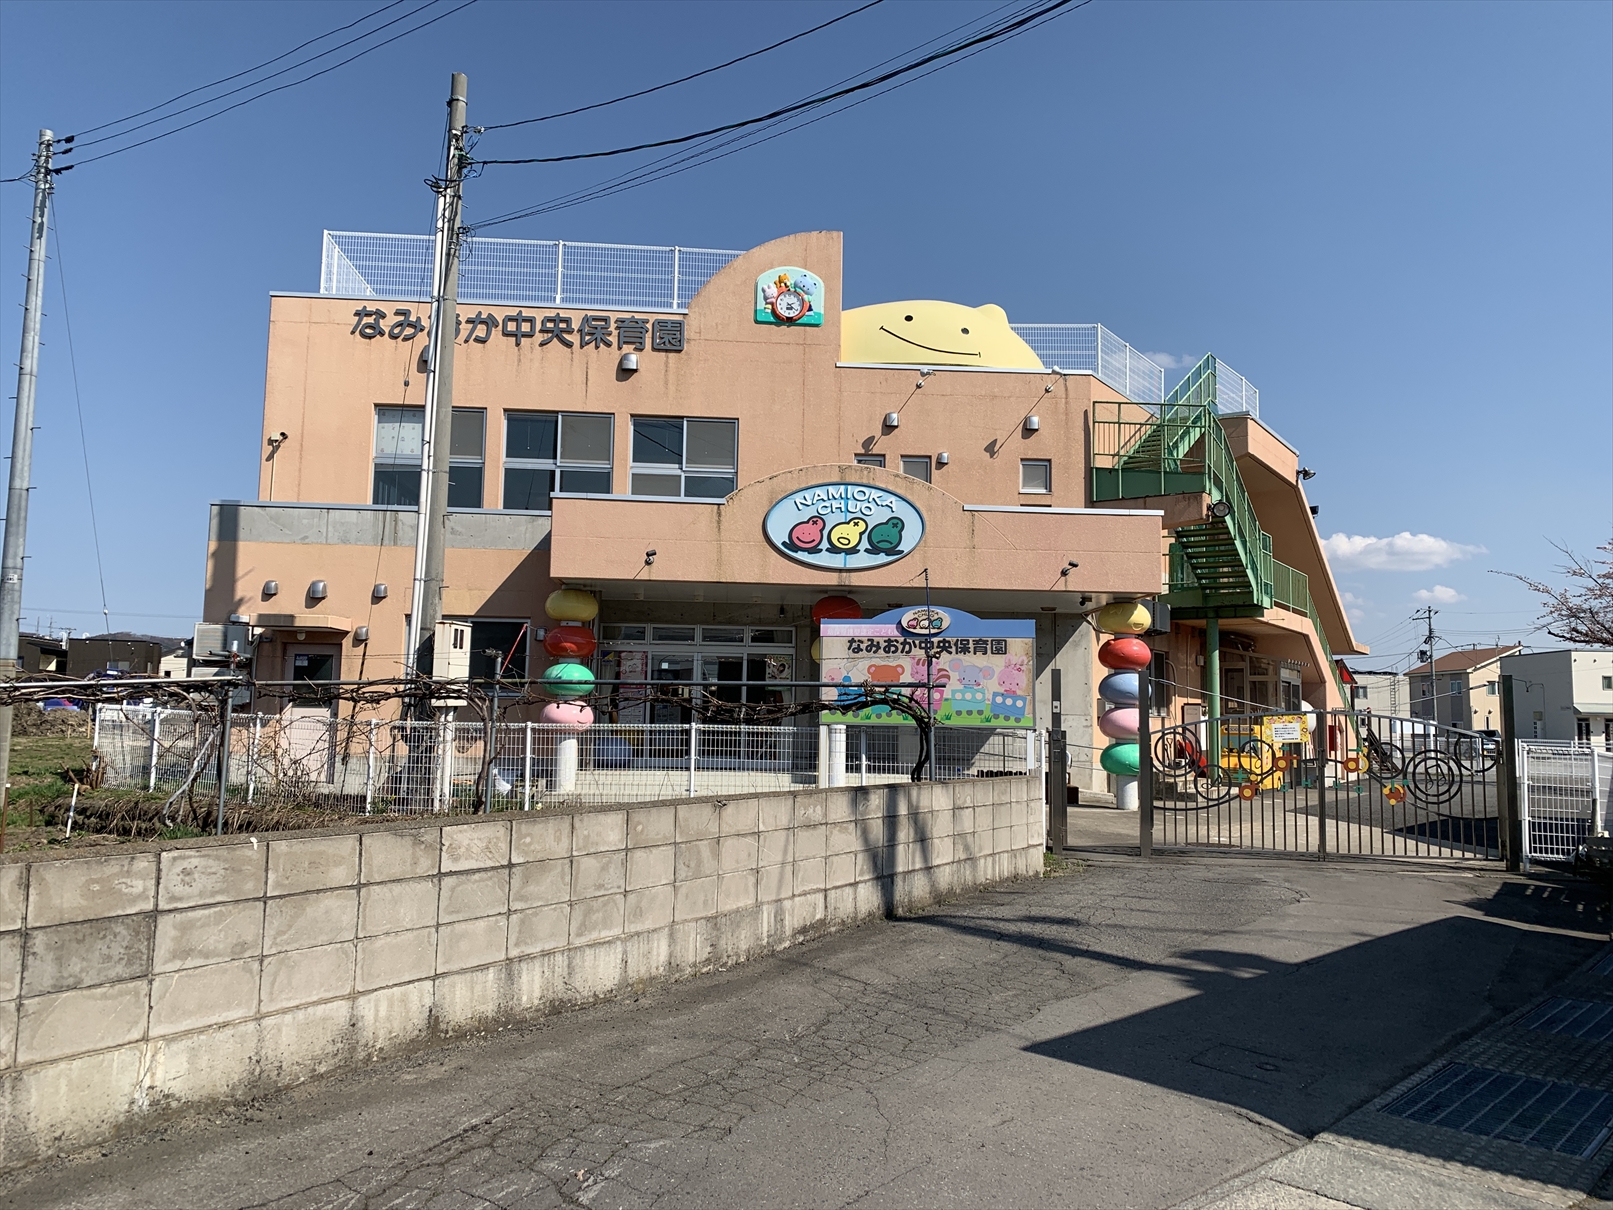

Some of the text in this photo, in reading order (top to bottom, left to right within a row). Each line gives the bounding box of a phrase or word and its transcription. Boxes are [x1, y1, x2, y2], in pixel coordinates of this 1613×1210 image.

[794, 485, 897, 513] NAMIOKA
[816, 500, 875, 516] CHUO
[847, 637, 1008, 655] なみおか中央保育園
